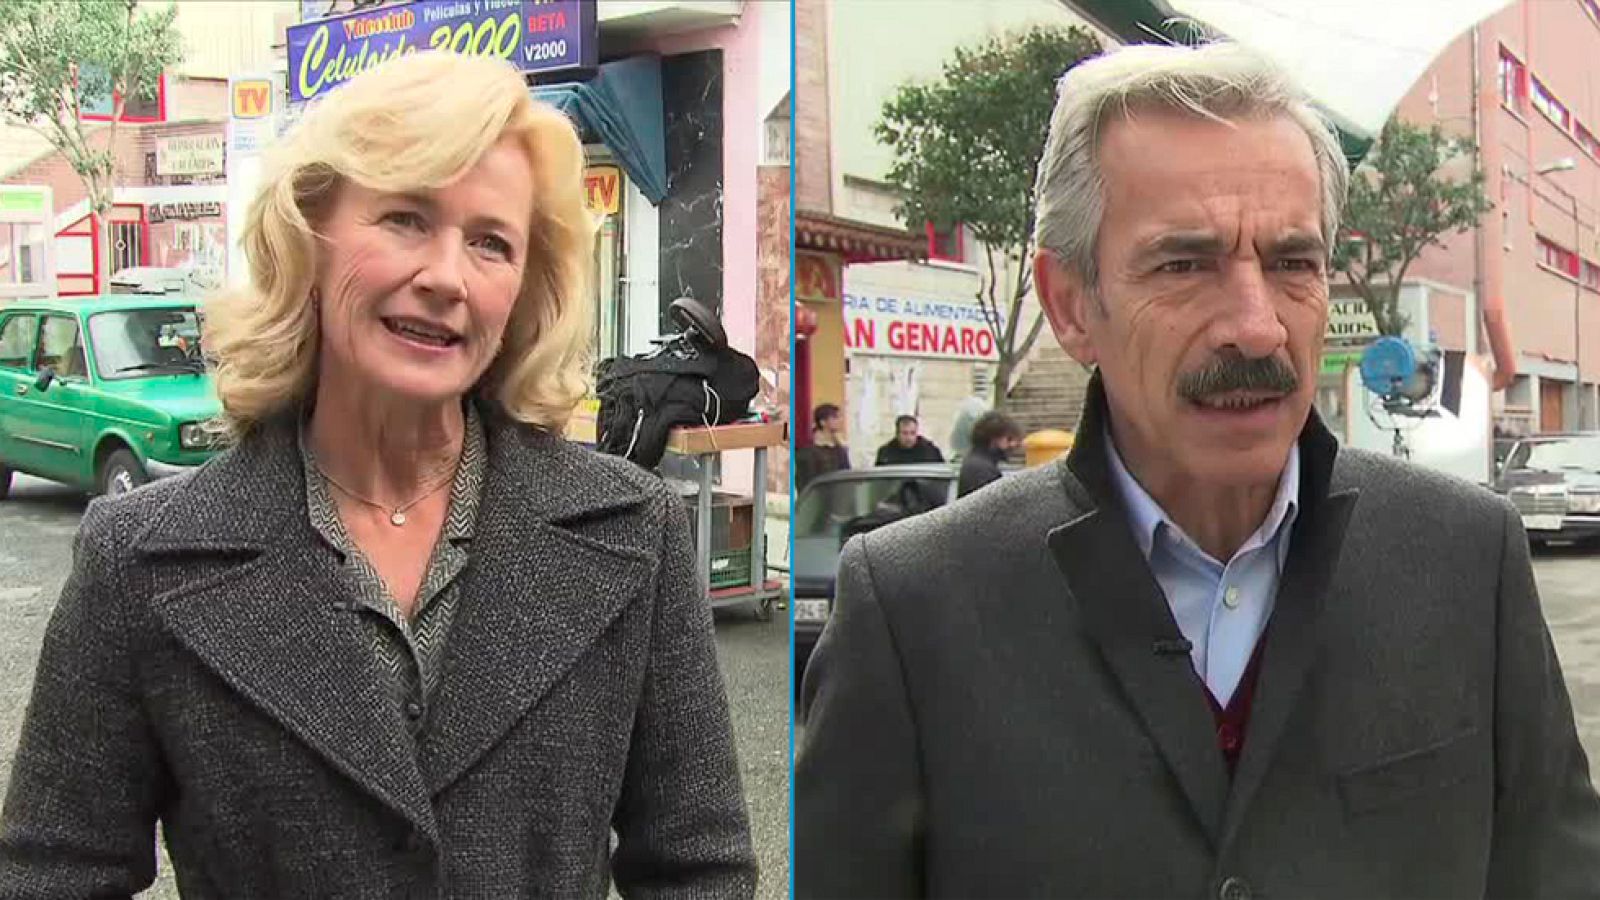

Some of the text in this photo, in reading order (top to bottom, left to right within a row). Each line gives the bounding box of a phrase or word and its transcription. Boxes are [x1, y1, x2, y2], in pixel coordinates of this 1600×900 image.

[528, 11, 566, 33] BETA
[430, 12, 521, 59] 2000
[525, 38, 566, 61] V2000
[238, 87, 268, 113] TV
[585, 175, 616, 207] TV
[876, 297, 897, 313] DE
[887, 319, 993, 356] GENARO
